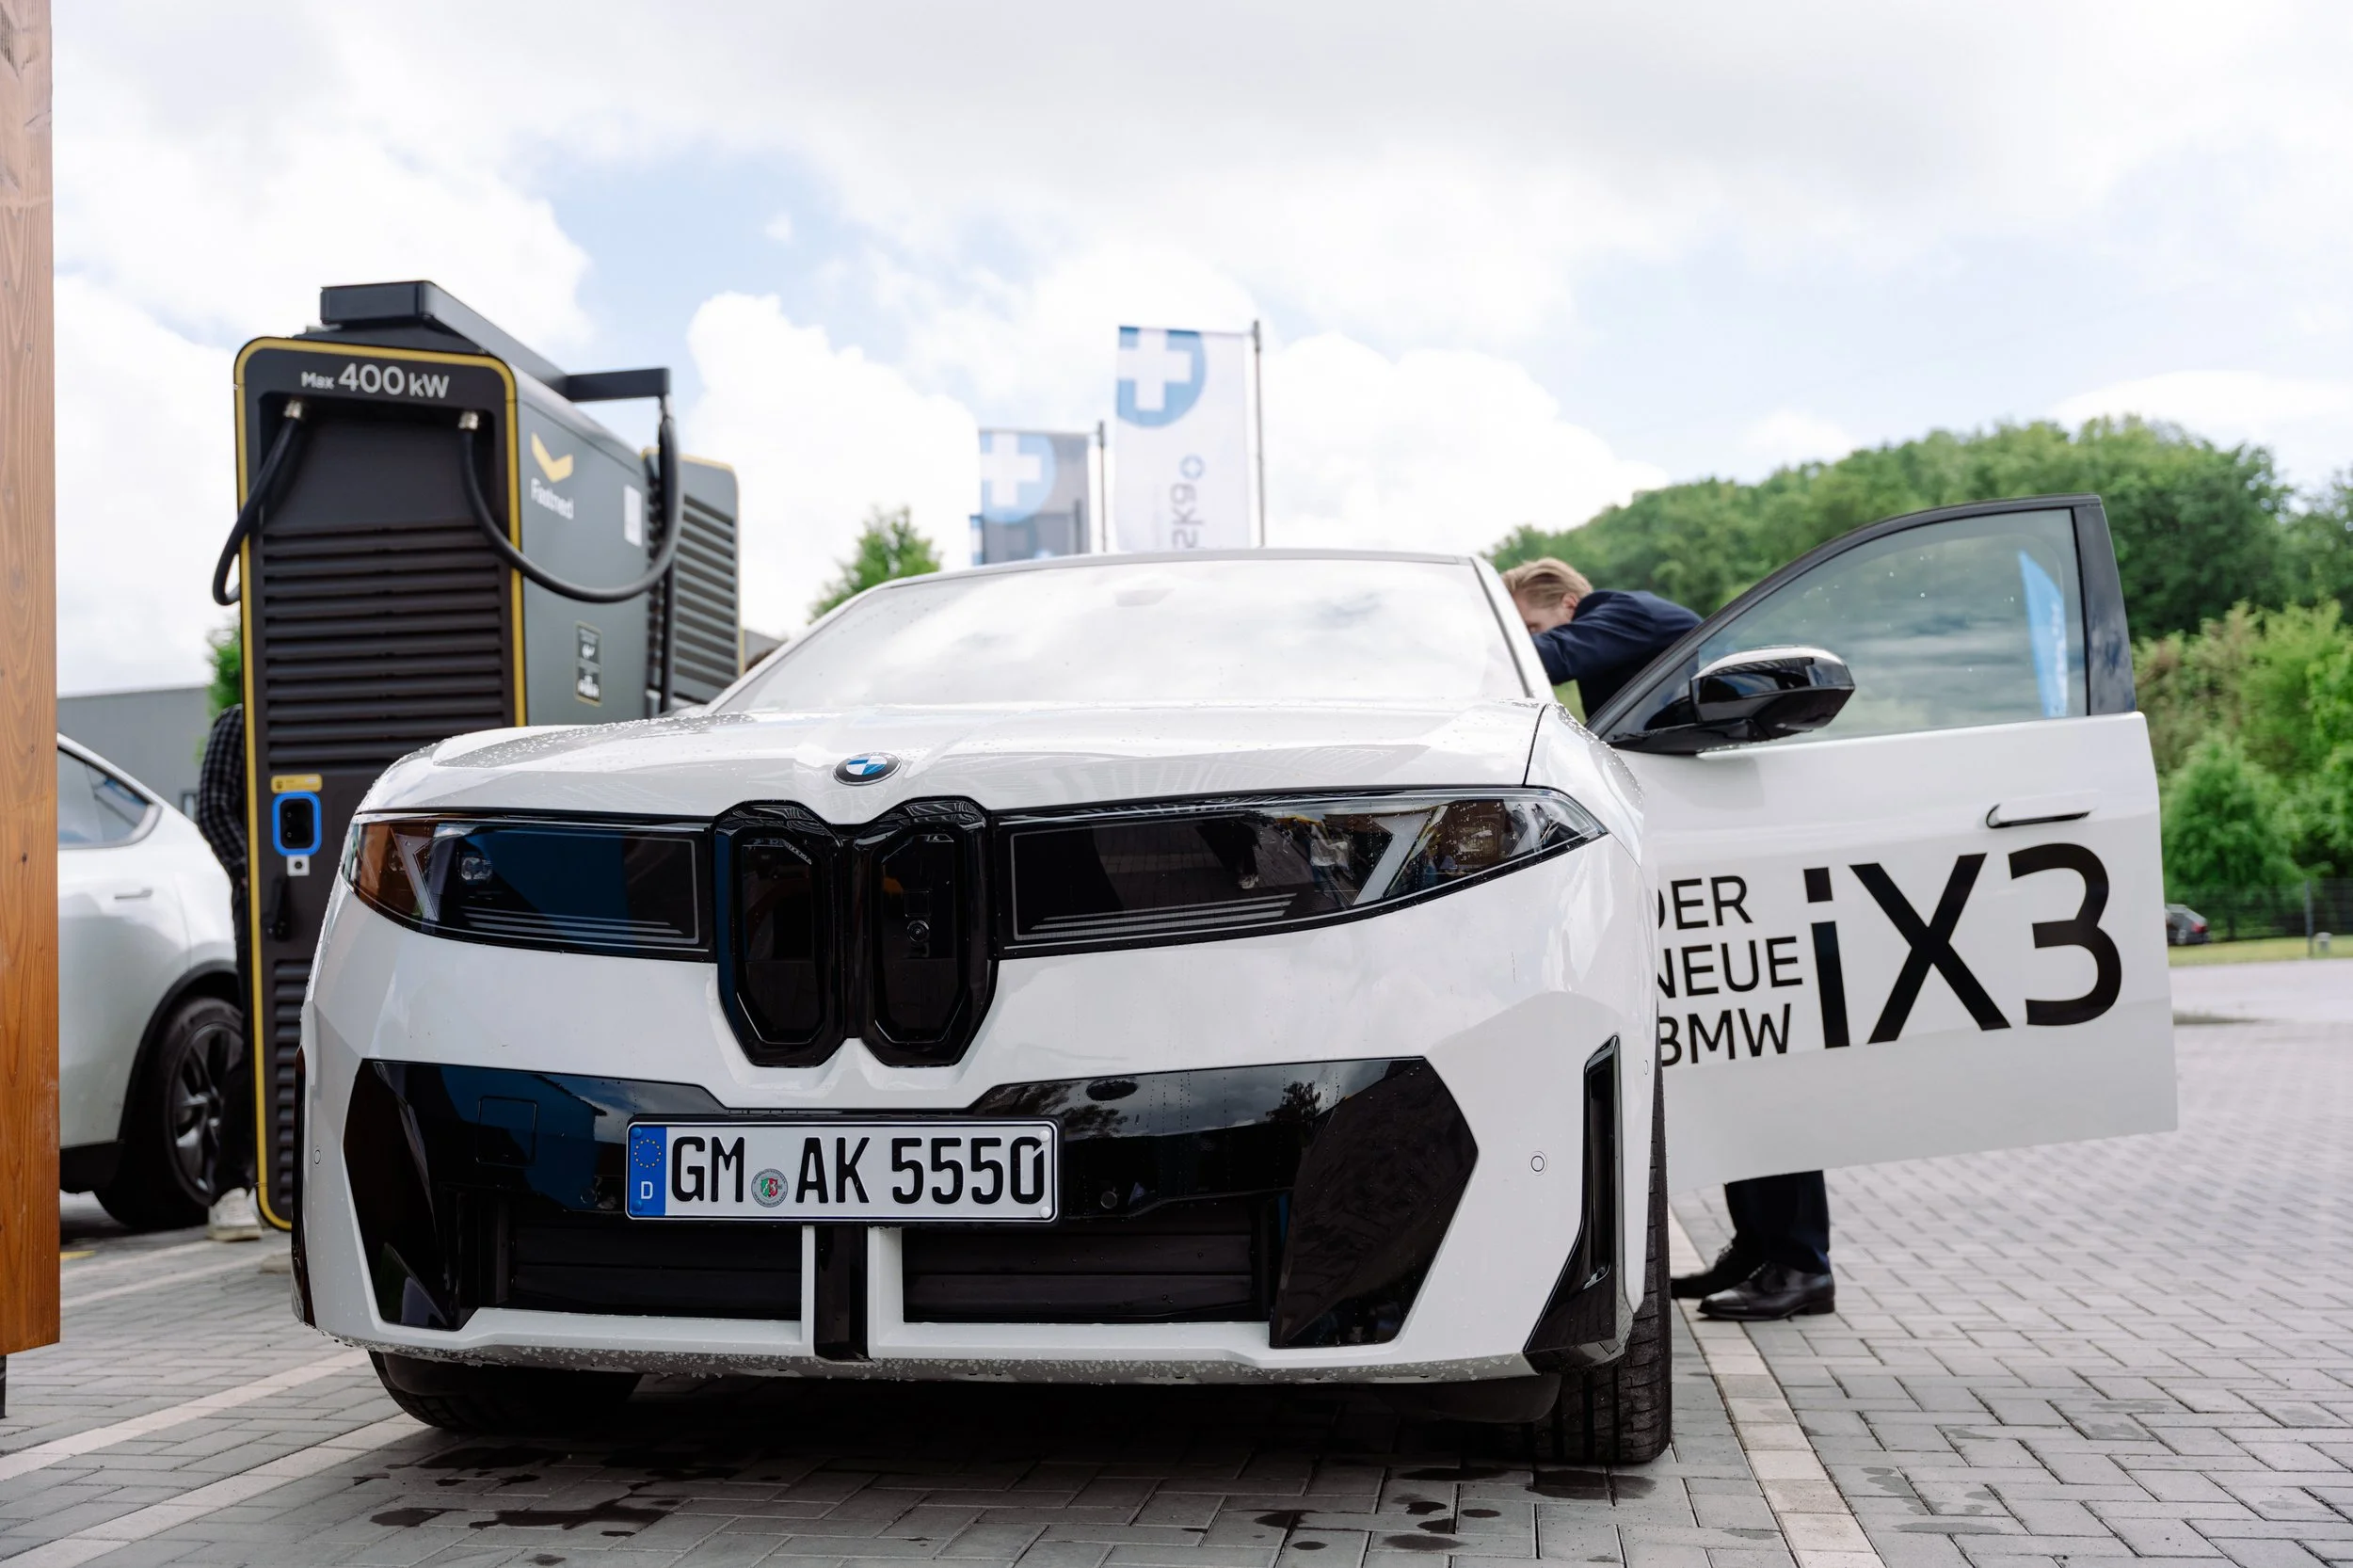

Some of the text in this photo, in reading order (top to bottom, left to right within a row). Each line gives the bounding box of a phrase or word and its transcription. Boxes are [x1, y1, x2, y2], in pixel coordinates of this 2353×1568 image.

[300, 362, 450, 399] Max 400 kW
[1657, 875, 1753, 930] ER
[1803, 842, 2121, 1049] iX3
[1658, 1002, 1791, 1067] BMW
[640, 1180, 653, 1200] D
[671, 1136, 745, 1203] GM
[795, 1137, 871, 1204] AK
[891, 1137, 1045, 1205] 5550
